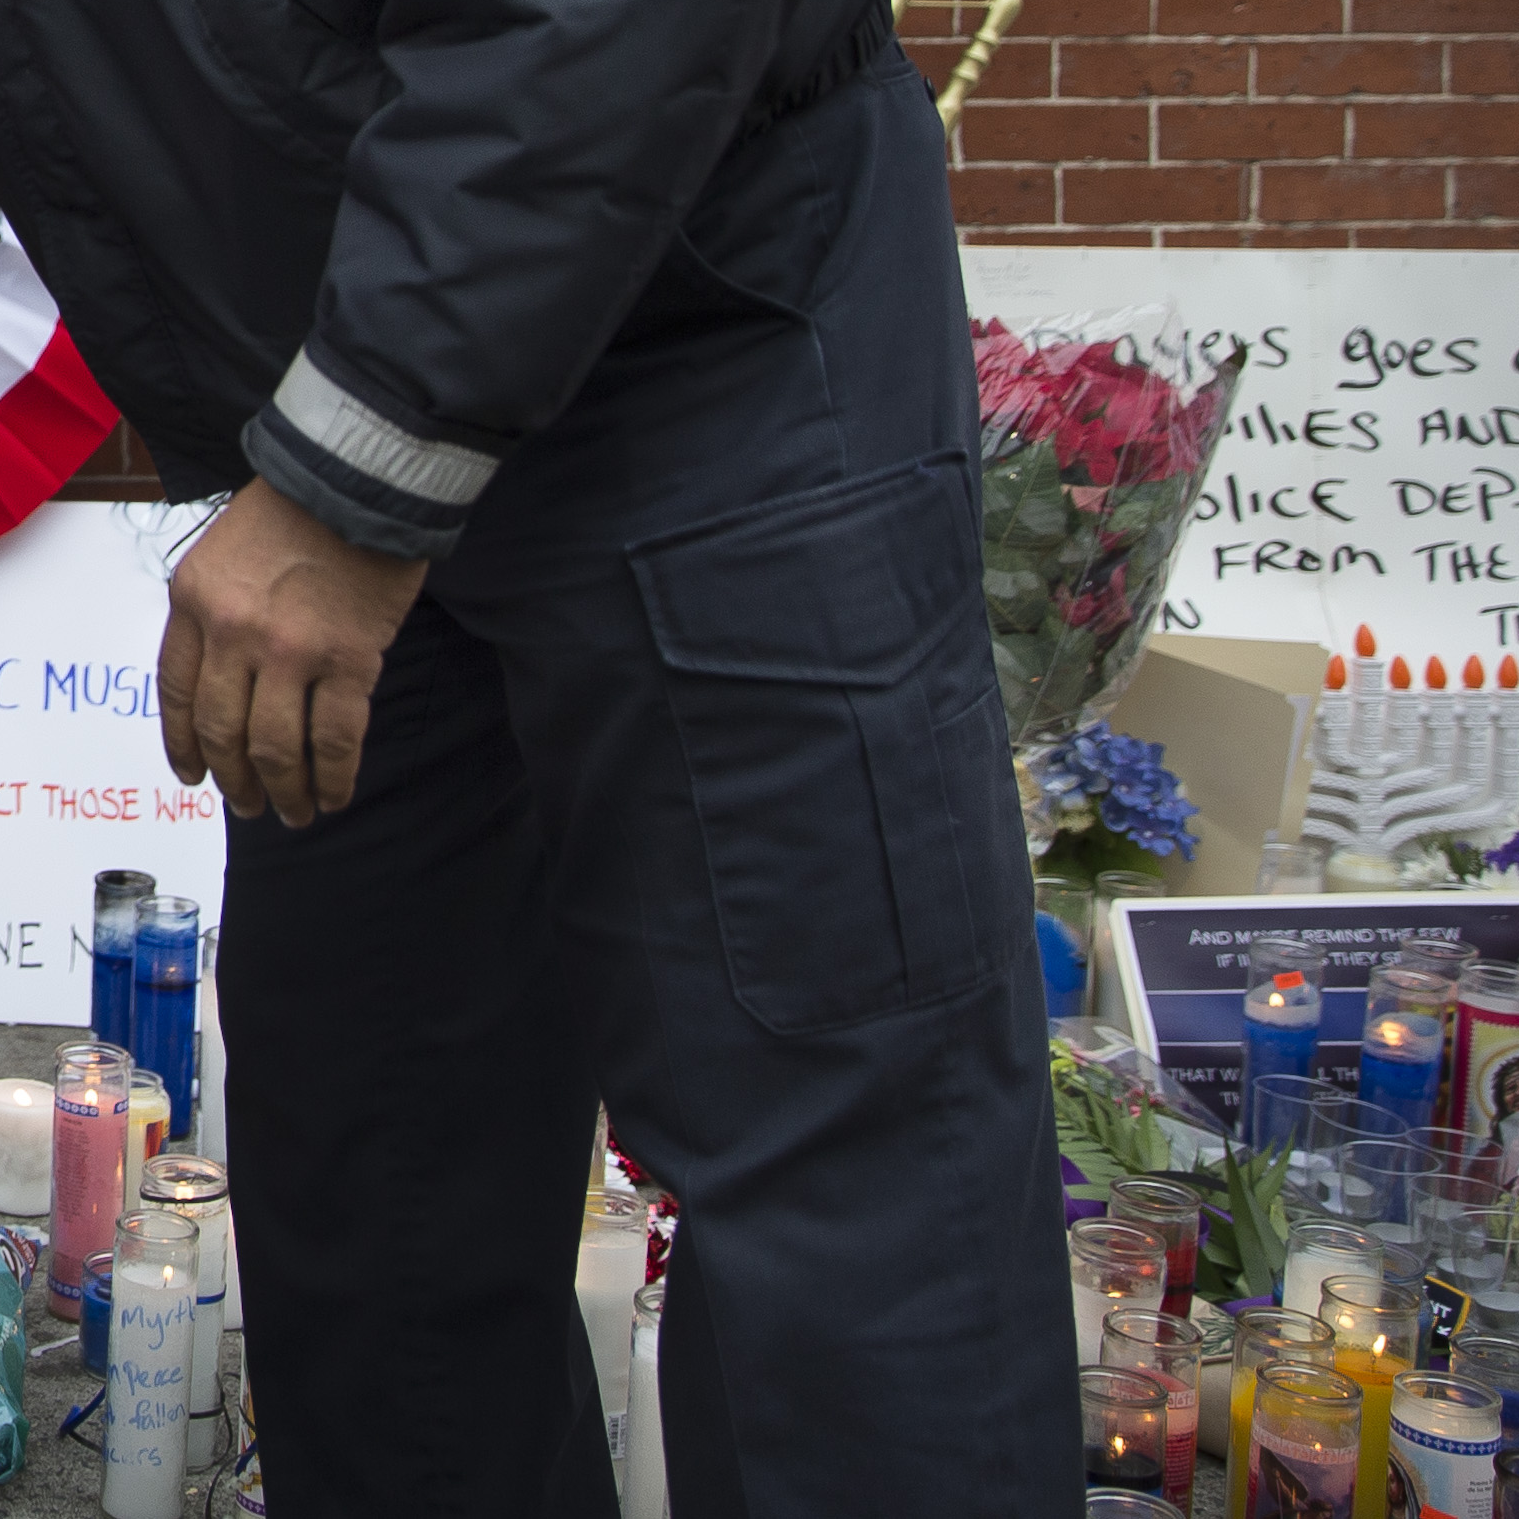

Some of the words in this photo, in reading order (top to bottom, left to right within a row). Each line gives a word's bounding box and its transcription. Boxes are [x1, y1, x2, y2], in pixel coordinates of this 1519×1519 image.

[1336, 325, 1481, 391] goes
[1213, 539, 1387, 580] FROM
[1412, 540, 1519, 583] THE
[42, 783, 141, 822] THOSE
[154, 785, 216, 823] WHO
[1188, 929, 1234, 947] AND
[1301, 928, 1374, 944] REMIND
[1329, 951, 1380, 967] THEY
[1170, 1067, 1215, 1082] THAT
[122, 1359, 184, 1397] Peace
[129, 1398, 186, 1431] fallen
